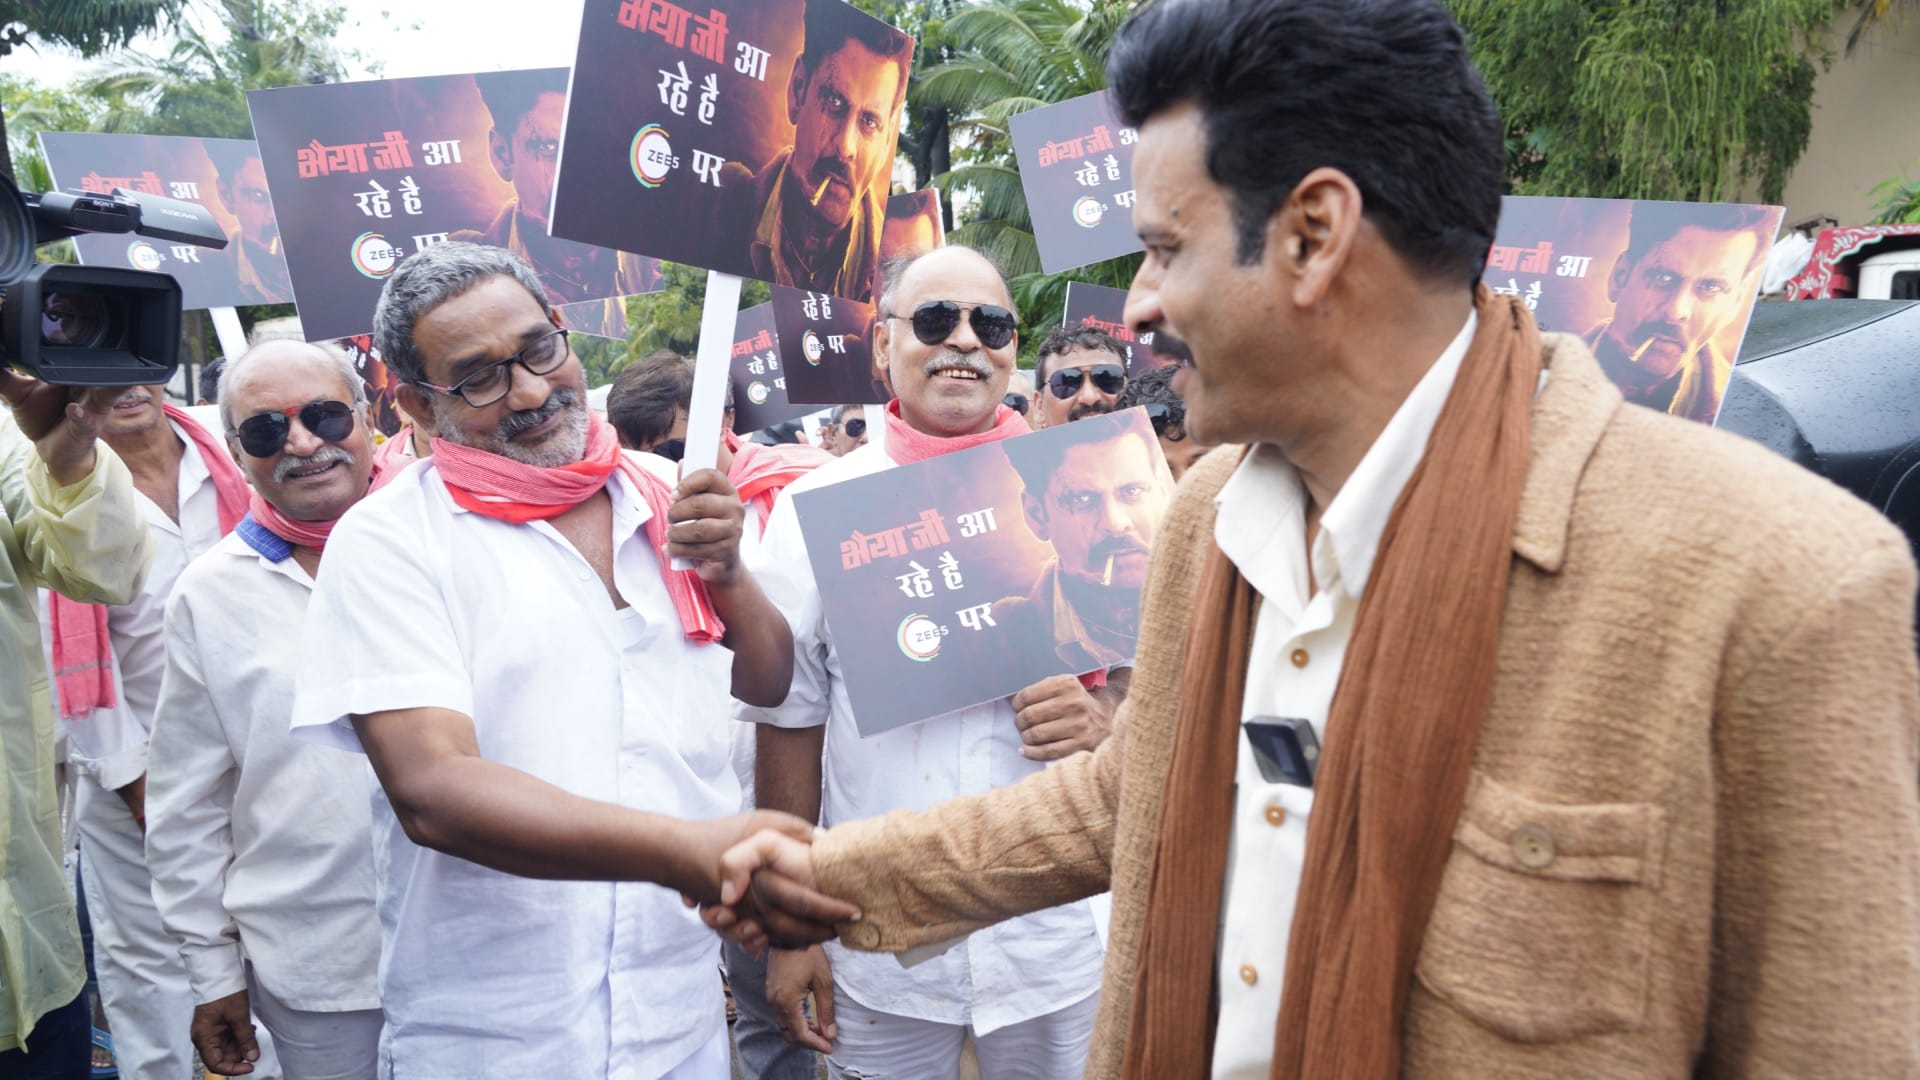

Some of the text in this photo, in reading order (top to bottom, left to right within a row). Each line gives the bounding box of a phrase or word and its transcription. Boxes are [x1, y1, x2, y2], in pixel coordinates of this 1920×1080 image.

[734, 41, 771, 82] आ
[656, 61, 720, 125] रहे है
[422, 139, 462, 166] आ
[647, 149, 680, 169] ZEE5
[692, 149, 726, 187] पर
[1074, 154, 1120, 187] रहे है
[170, 181, 200, 200] आ
[353, 176, 423, 219] रहे है
[93, 199, 115, 208] SONY
[170, 245, 200, 263] पर
[370, 247, 404, 261] ZEE5
[1556, 255, 1592, 278] आ
[802, 291, 818, 320] रहे
[827, 335, 846, 354] पर
[747, 355, 765, 375] रहे
[773, 377, 786, 390] प
[957, 507, 998, 538] आ
[895, 551, 964, 599] रहे है
[956, 602, 997, 632] पर
[915, 625, 949, 642] ZEE5
